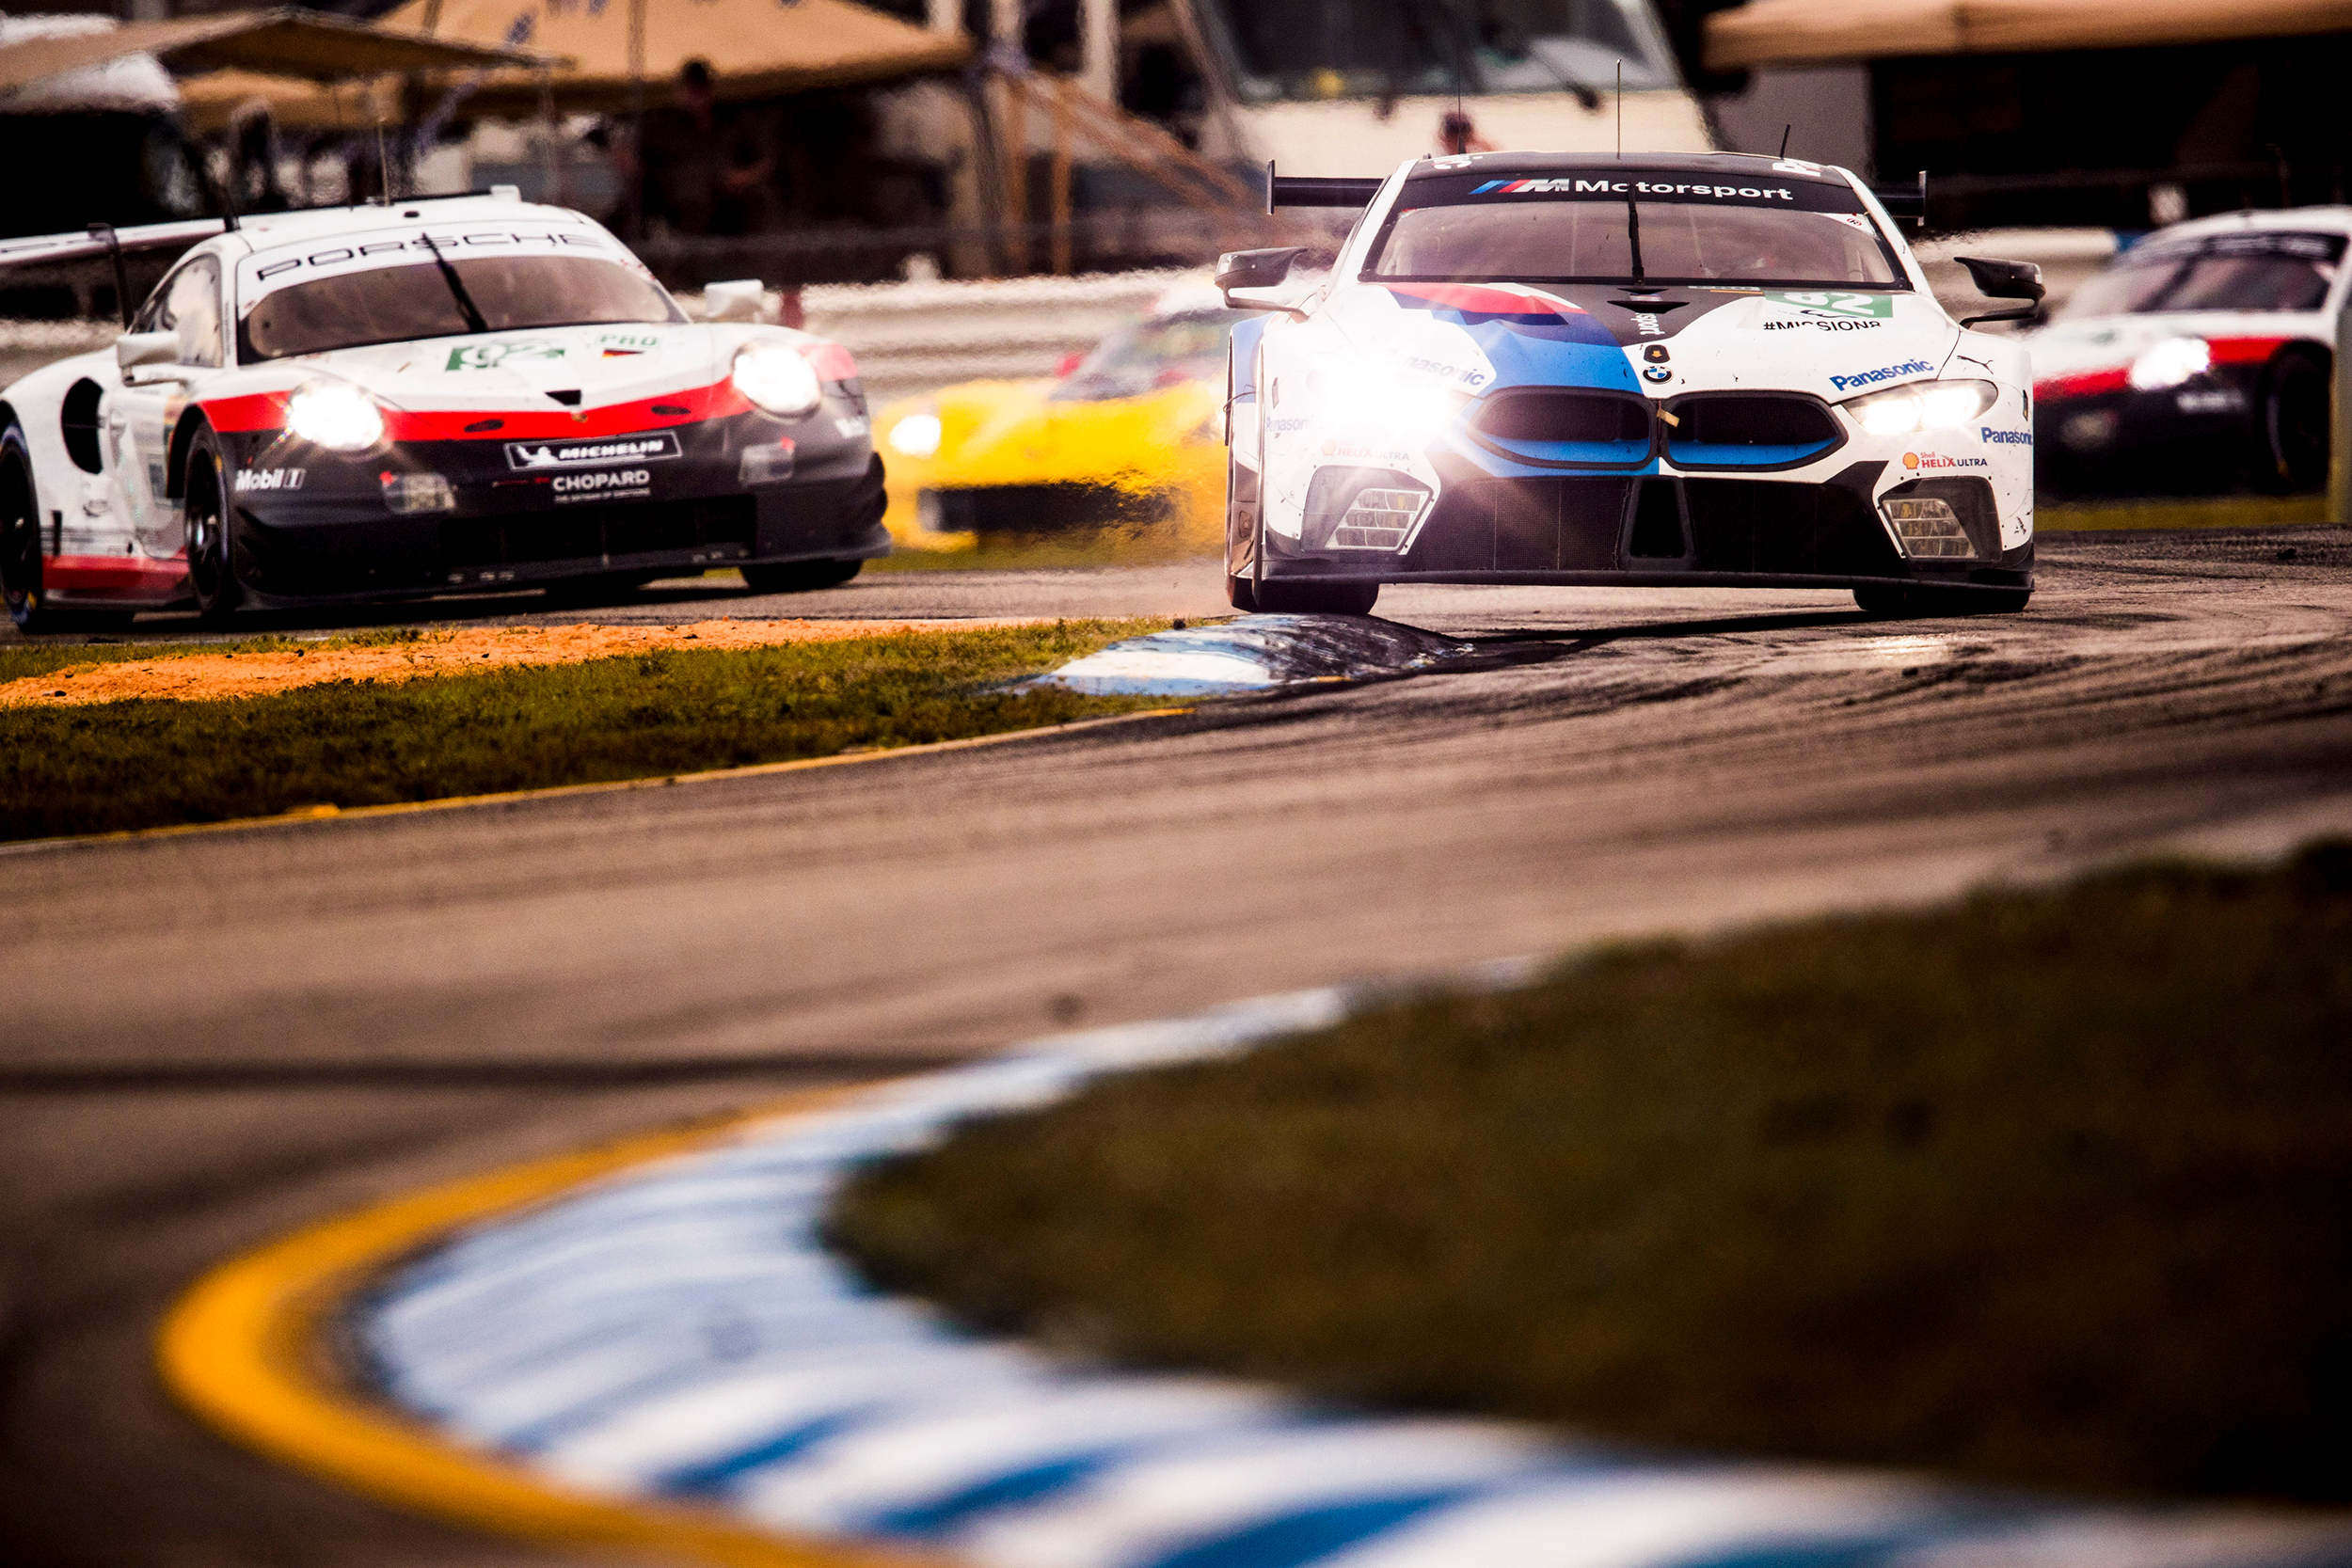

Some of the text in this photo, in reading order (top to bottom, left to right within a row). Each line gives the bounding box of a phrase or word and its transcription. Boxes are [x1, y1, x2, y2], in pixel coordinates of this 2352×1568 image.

[1575, 180, 1794, 200] Motorsport
[256, 232, 606, 282] PORSCHE
[1629, 312, 1666, 336] sport
[1829, 358, 1934, 391] Panasonic
[1980, 427, 2033, 446] Panasoni
[559, 438, 664, 460] MICHELIN
[1338, 446, 1373, 458] HELIX
[1921, 456, 1988, 468] HELIX ULTRA
[235, 468, 285, 492] Mobil
[552, 469, 651, 491] CHOPARD
